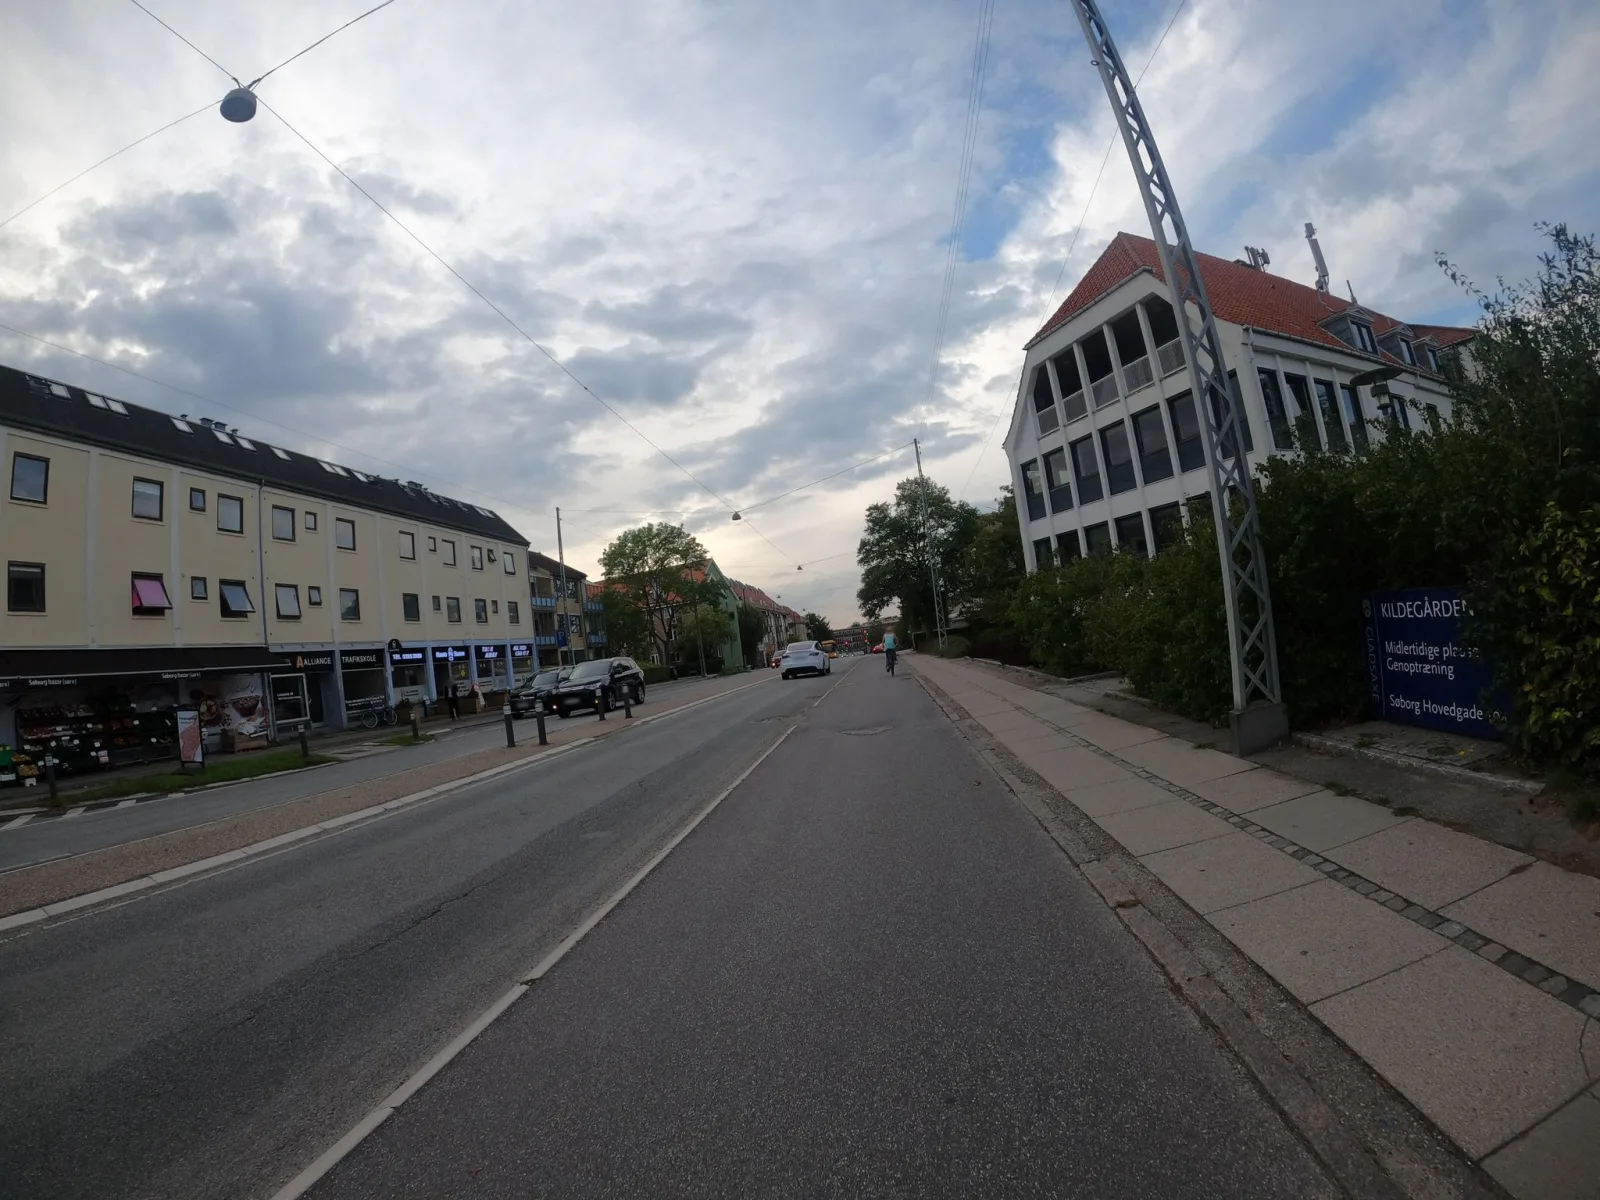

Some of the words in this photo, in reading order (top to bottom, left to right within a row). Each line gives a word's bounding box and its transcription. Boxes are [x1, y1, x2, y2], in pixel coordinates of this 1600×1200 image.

[303, 657, 332, 666] ALLIANCE
[341, 654, 377, 664] TRAFIKSKOLE
[1385, 640, 1440, 661] Midlertidige
[1365, 627, 1380, 703] GLADSAXE
[1386, 657, 1455, 681] Genoptræning
[1388, 693, 1421, 716] Søborg
[1423, 699, 1484, 722] Hovedgade
